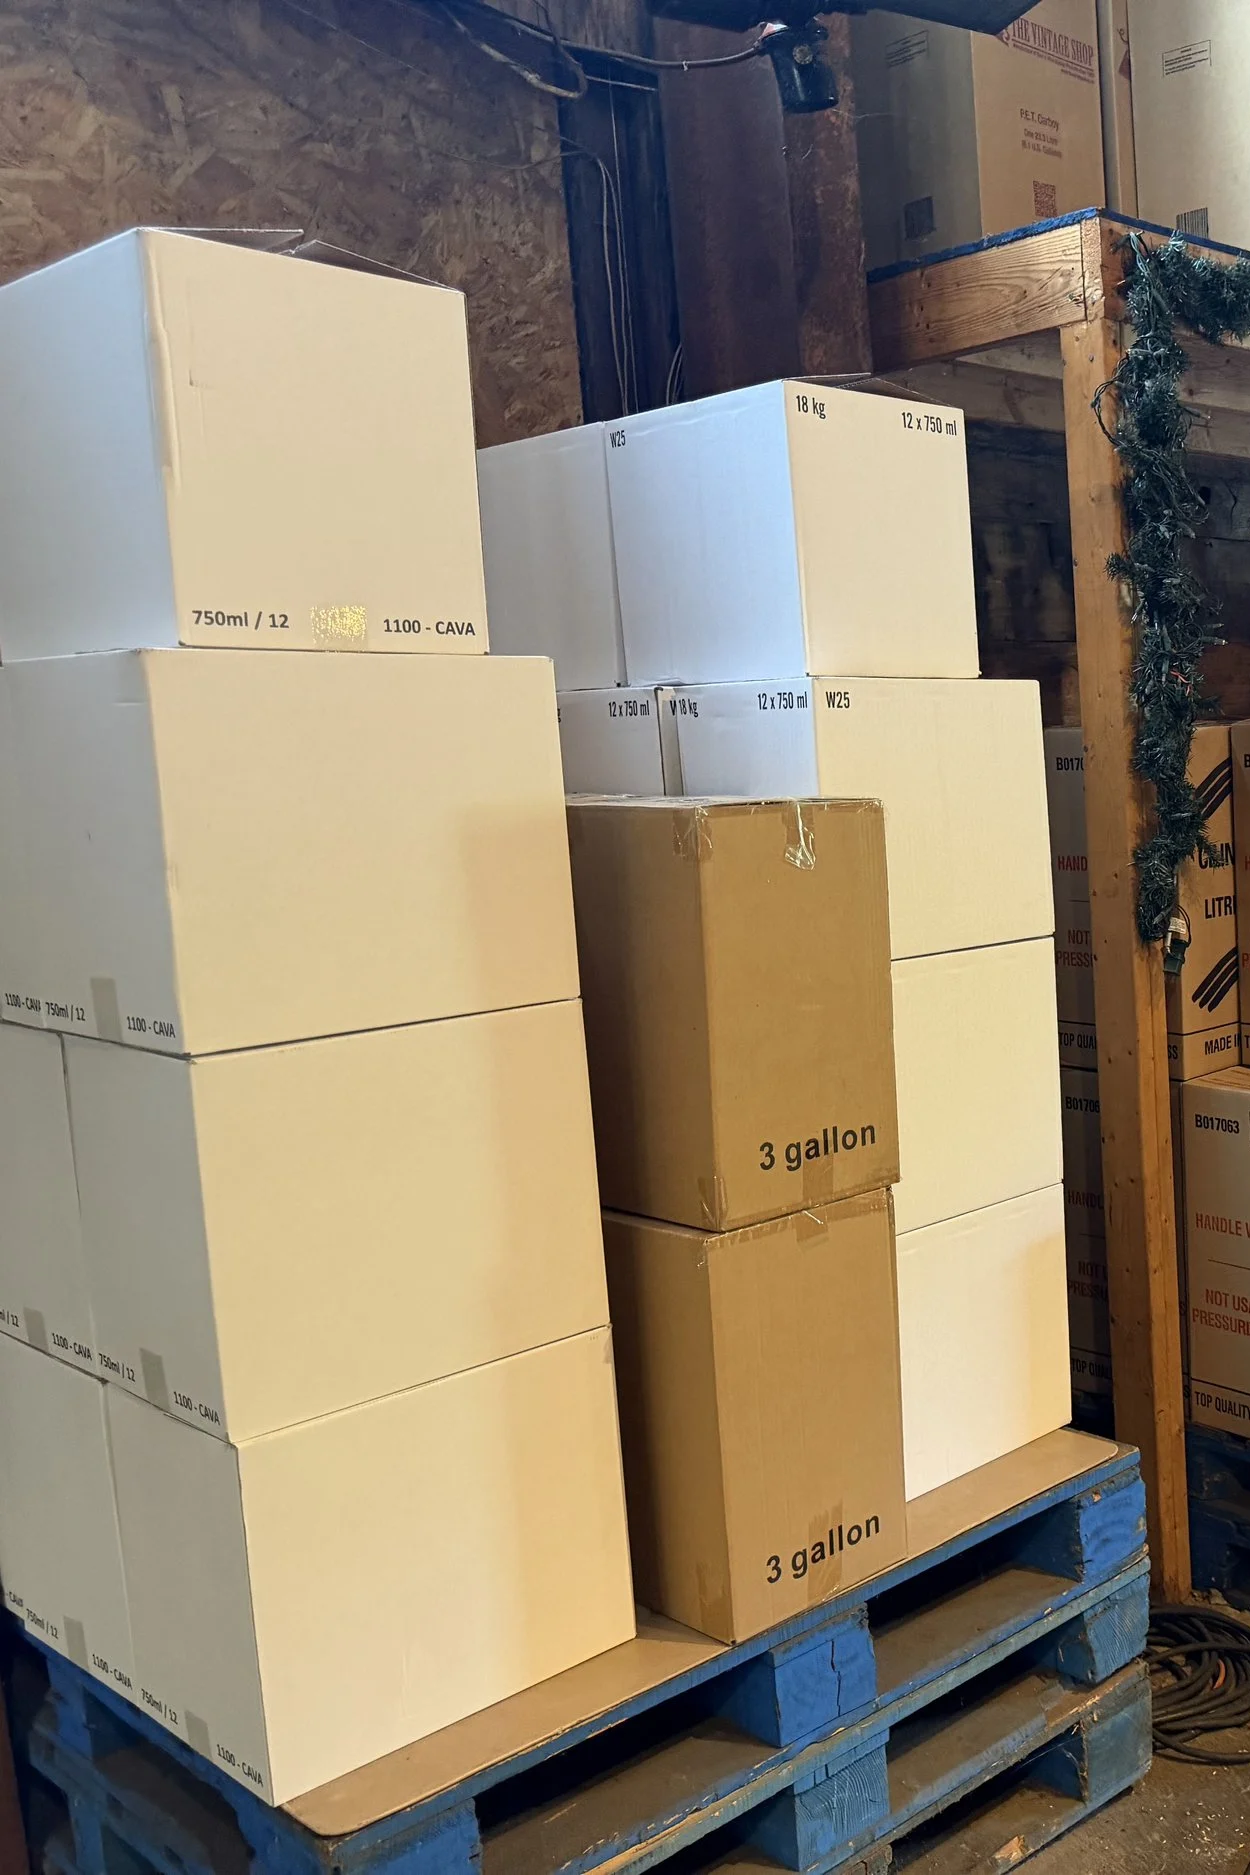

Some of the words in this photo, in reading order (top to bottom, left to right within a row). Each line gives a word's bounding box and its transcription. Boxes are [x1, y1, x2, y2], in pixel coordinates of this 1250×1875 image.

[1012, 18, 1030, 42] THE
[1031, 22, 1070, 58] VINTAGE
[1071, 39, 1094, 66] SHOP
[1038, 114, 1060, 132] Carboy
[795, 394, 809, 415] 18
[812, 397, 826, 420] kg
[901, 411, 914, 430] 12
[916, 418, 922, 432] x
[924, 414, 943, 435] 750
[945, 418, 958, 436] ml
[610, 430, 626, 450] W25
[192, 610, 248, 628] 750ml
[254, 611, 263, 630] /
[268, 613, 290, 629] 12
[384, 618, 420, 634] 1100
[435, 620, 476, 636] CAVA
[608, 702, 617, 718] 12
[624, 700, 638, 716] 750
[640, 700, 650, 716] ml
[679, 698, 689, 716] 18
[690, 700, 699, 718] kg
[758, 692, 768, 710] 12
[770, 696, 776, 709] x
[778, 692, 794, 710] 750
[796, 691, 808, 709] ml
[826, 691, 850, 709] W25
[1068, 929, 1090, 946] NOT
[4, 993, 21, 1008] 1100
[45, 1001, 69, 1019] 750ml
[70, 1004, 74, 1022] /
[76, 1006, 86, 1022] 12
[126, 1016, 147, 1033] 1100
[153, 1020, 176, 1038] CAVA
[1059, 1032, 1075, 1048] TOP
[1204, 1036, 1232, 1055] MADE
[1194, 1113, 1240, 1134] B017063
[760, 1142, 776, 1171] 3
[785, 1124, 876, 1172] gallon
[1195, 1212, 1242, 1238] HANDLE
[1205, 1288, 1230, 1309] NOT
[11, 1314, 20, 1328] 12
[52, 1332, 69, 1350] 1100
[73, 1342, 92, 1361] CAVA
[98, 1352, 120, 1374] 750ml
[122, 1362, 125, 1378] /
[126, 1367, 136, 1383] 12
[173, 1391, 193, 1412] 1100
[198, 1402, 220, 1426] CAVA
[1194, 1390, 1212, 1407] TOP
[766, 1554, 782, 1584] 3
[792, 1515, 880, 1580] gallon
[26, 1608, 45, 1630] 750ml
[50, 1625, 59, 1640] 12
[92, 1653, 109, 1674] 1100
[114, 1667, 133, 1690] CAVA
[140, 1688, 162, 1714] 750ml
[169, 1708, 178, 1725] 12
[216, 1744, 236, 1768] 1100
[242, 1762, 264, 1788] CAVA
